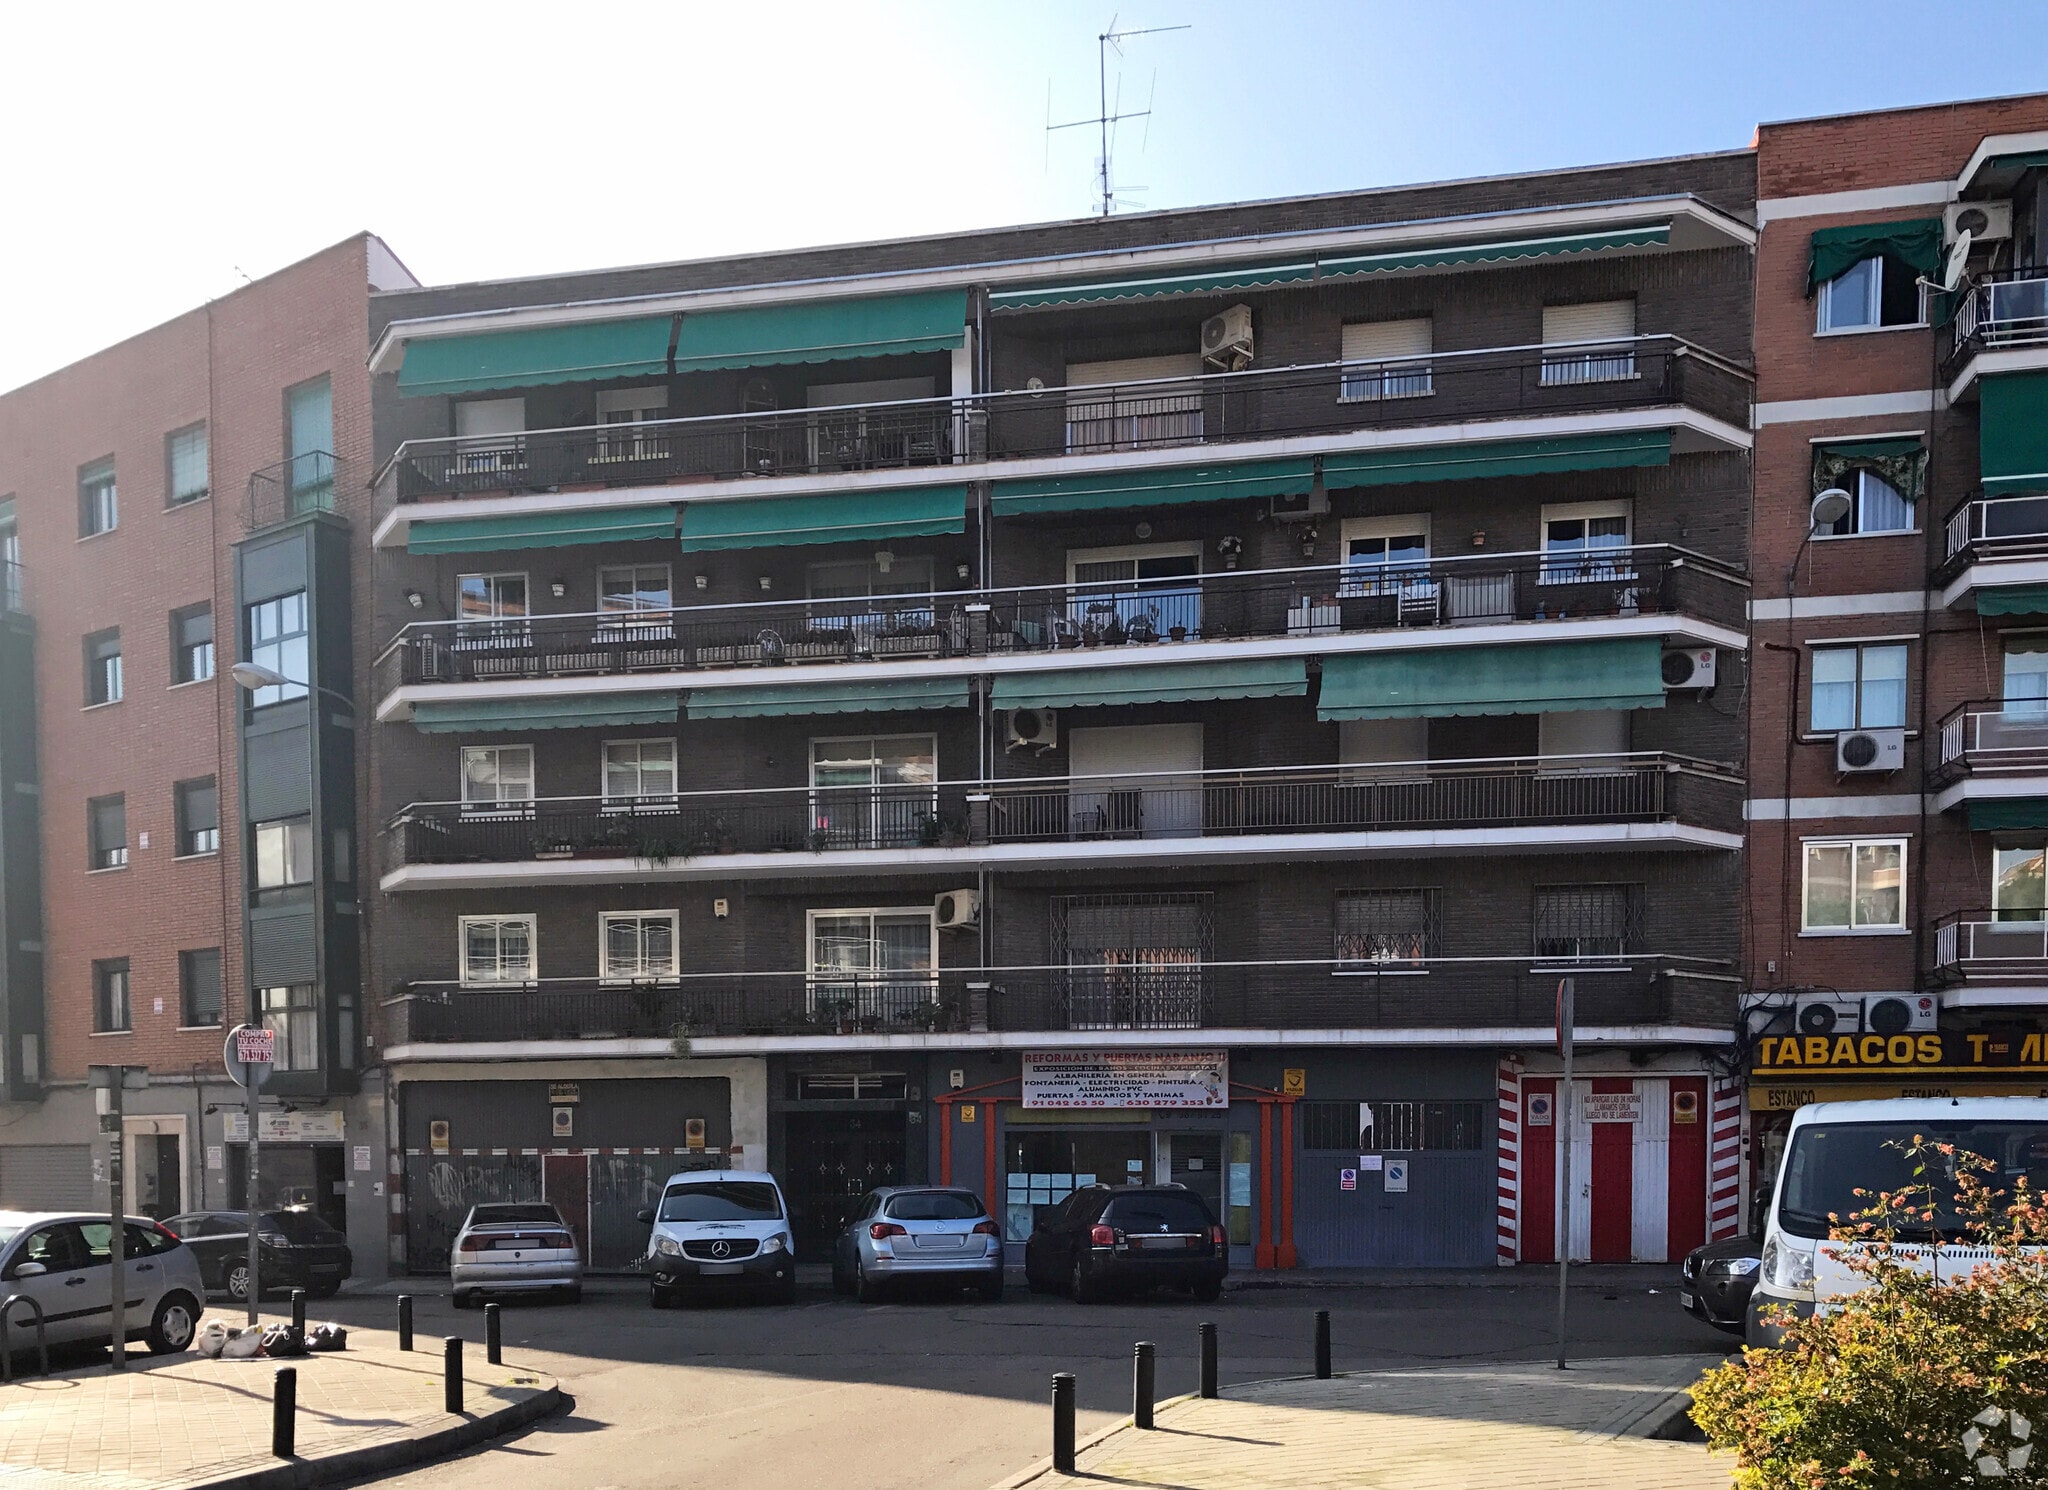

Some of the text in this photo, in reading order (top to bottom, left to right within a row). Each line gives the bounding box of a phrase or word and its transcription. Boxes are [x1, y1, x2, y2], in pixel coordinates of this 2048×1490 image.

[240, 1030, 270, 1038] COMPRO
[1759, 1035, 1942, 1065] TABACOS
[1024, 1053, 1089, 1063] REFORMAS
[1092, 1053, 1100, 1062] Y
[1103, 1052, 1152, 1063] PUERTAS
[1155, 1052, 1214, 1062] NARANJO
[1583, 1095, 1591, 1104] NO
[1591, 1095, 1610, 1104] APARCAR
[1610, 1095, 1620, 1104] LAS
[1626, 1095, 1641, 1104] HORAS
[1768, 1089, 1815, 1107] ESTANCO
